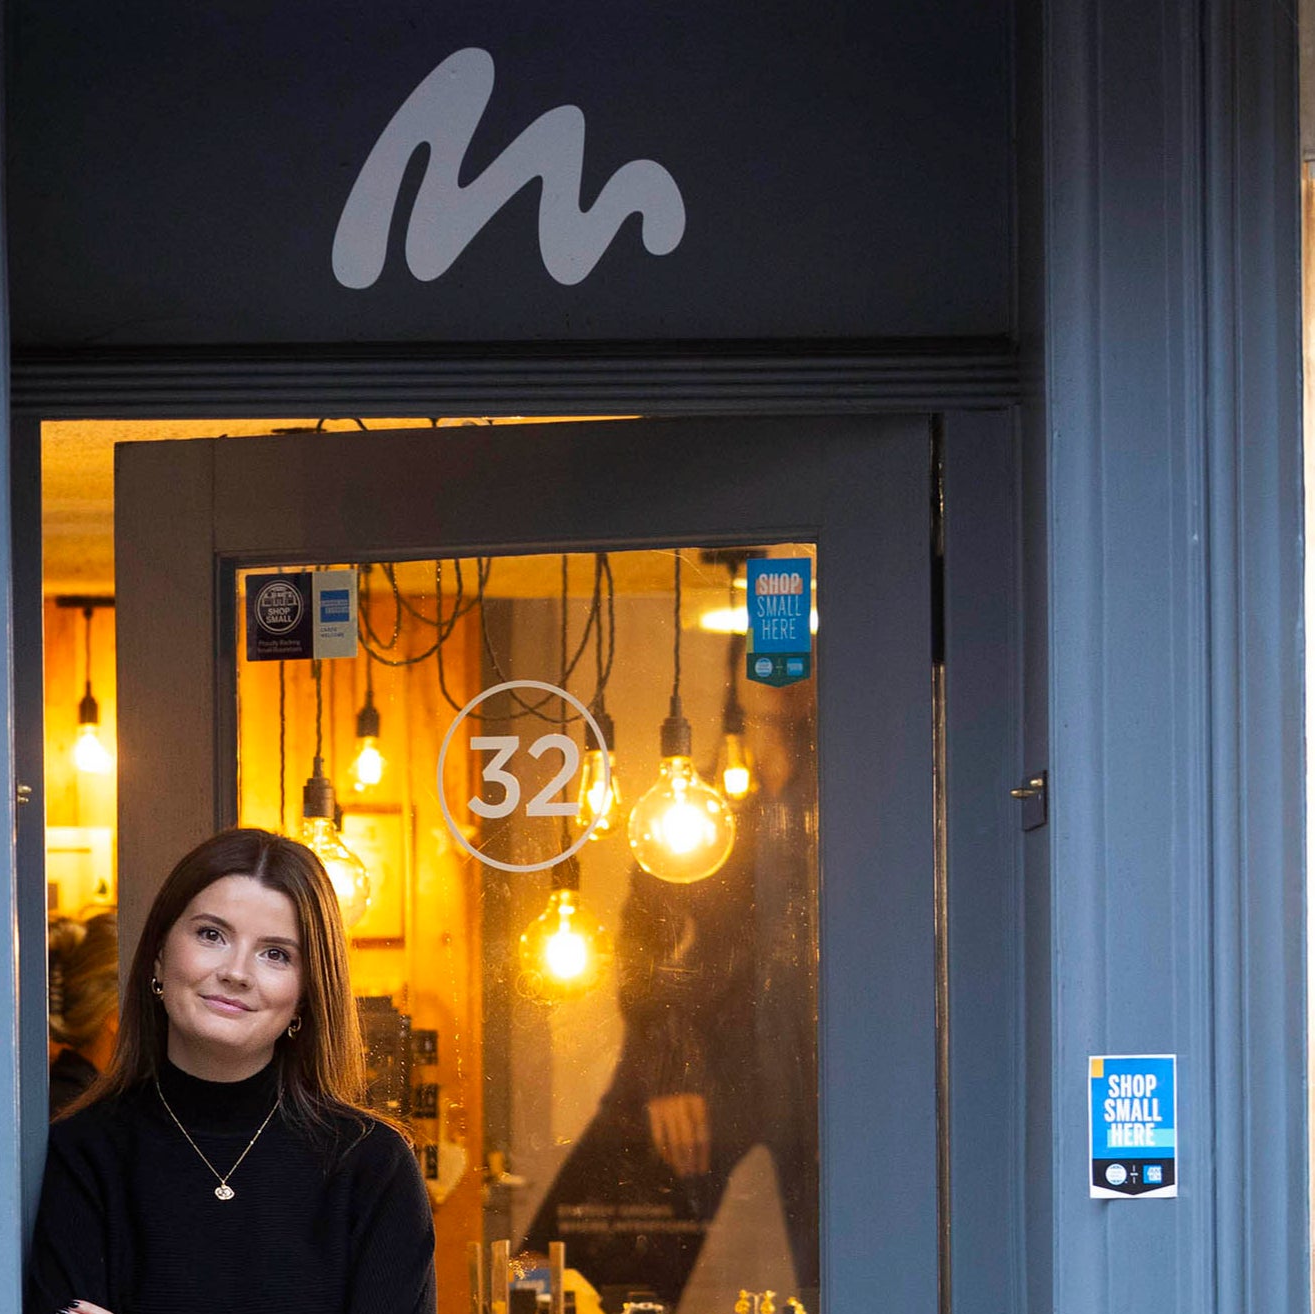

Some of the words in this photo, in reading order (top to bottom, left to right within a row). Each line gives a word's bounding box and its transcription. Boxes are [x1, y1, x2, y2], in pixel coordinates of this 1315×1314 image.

[759, 573, 800, 594] SHOP
[268, 607, 291, 615] SHOP
[757, 596, 802, 617] SMALL
[266, 615, 293, 624] SMALL
[762, 618, 797, 640] HERE
[467, 733, 582, 820] 32
[1108, 1074, 1157, 1098] SHOP
[1104, 1098, 1162, 1122] SMALL
[1110, 1123, 1156, 1147] HERE
